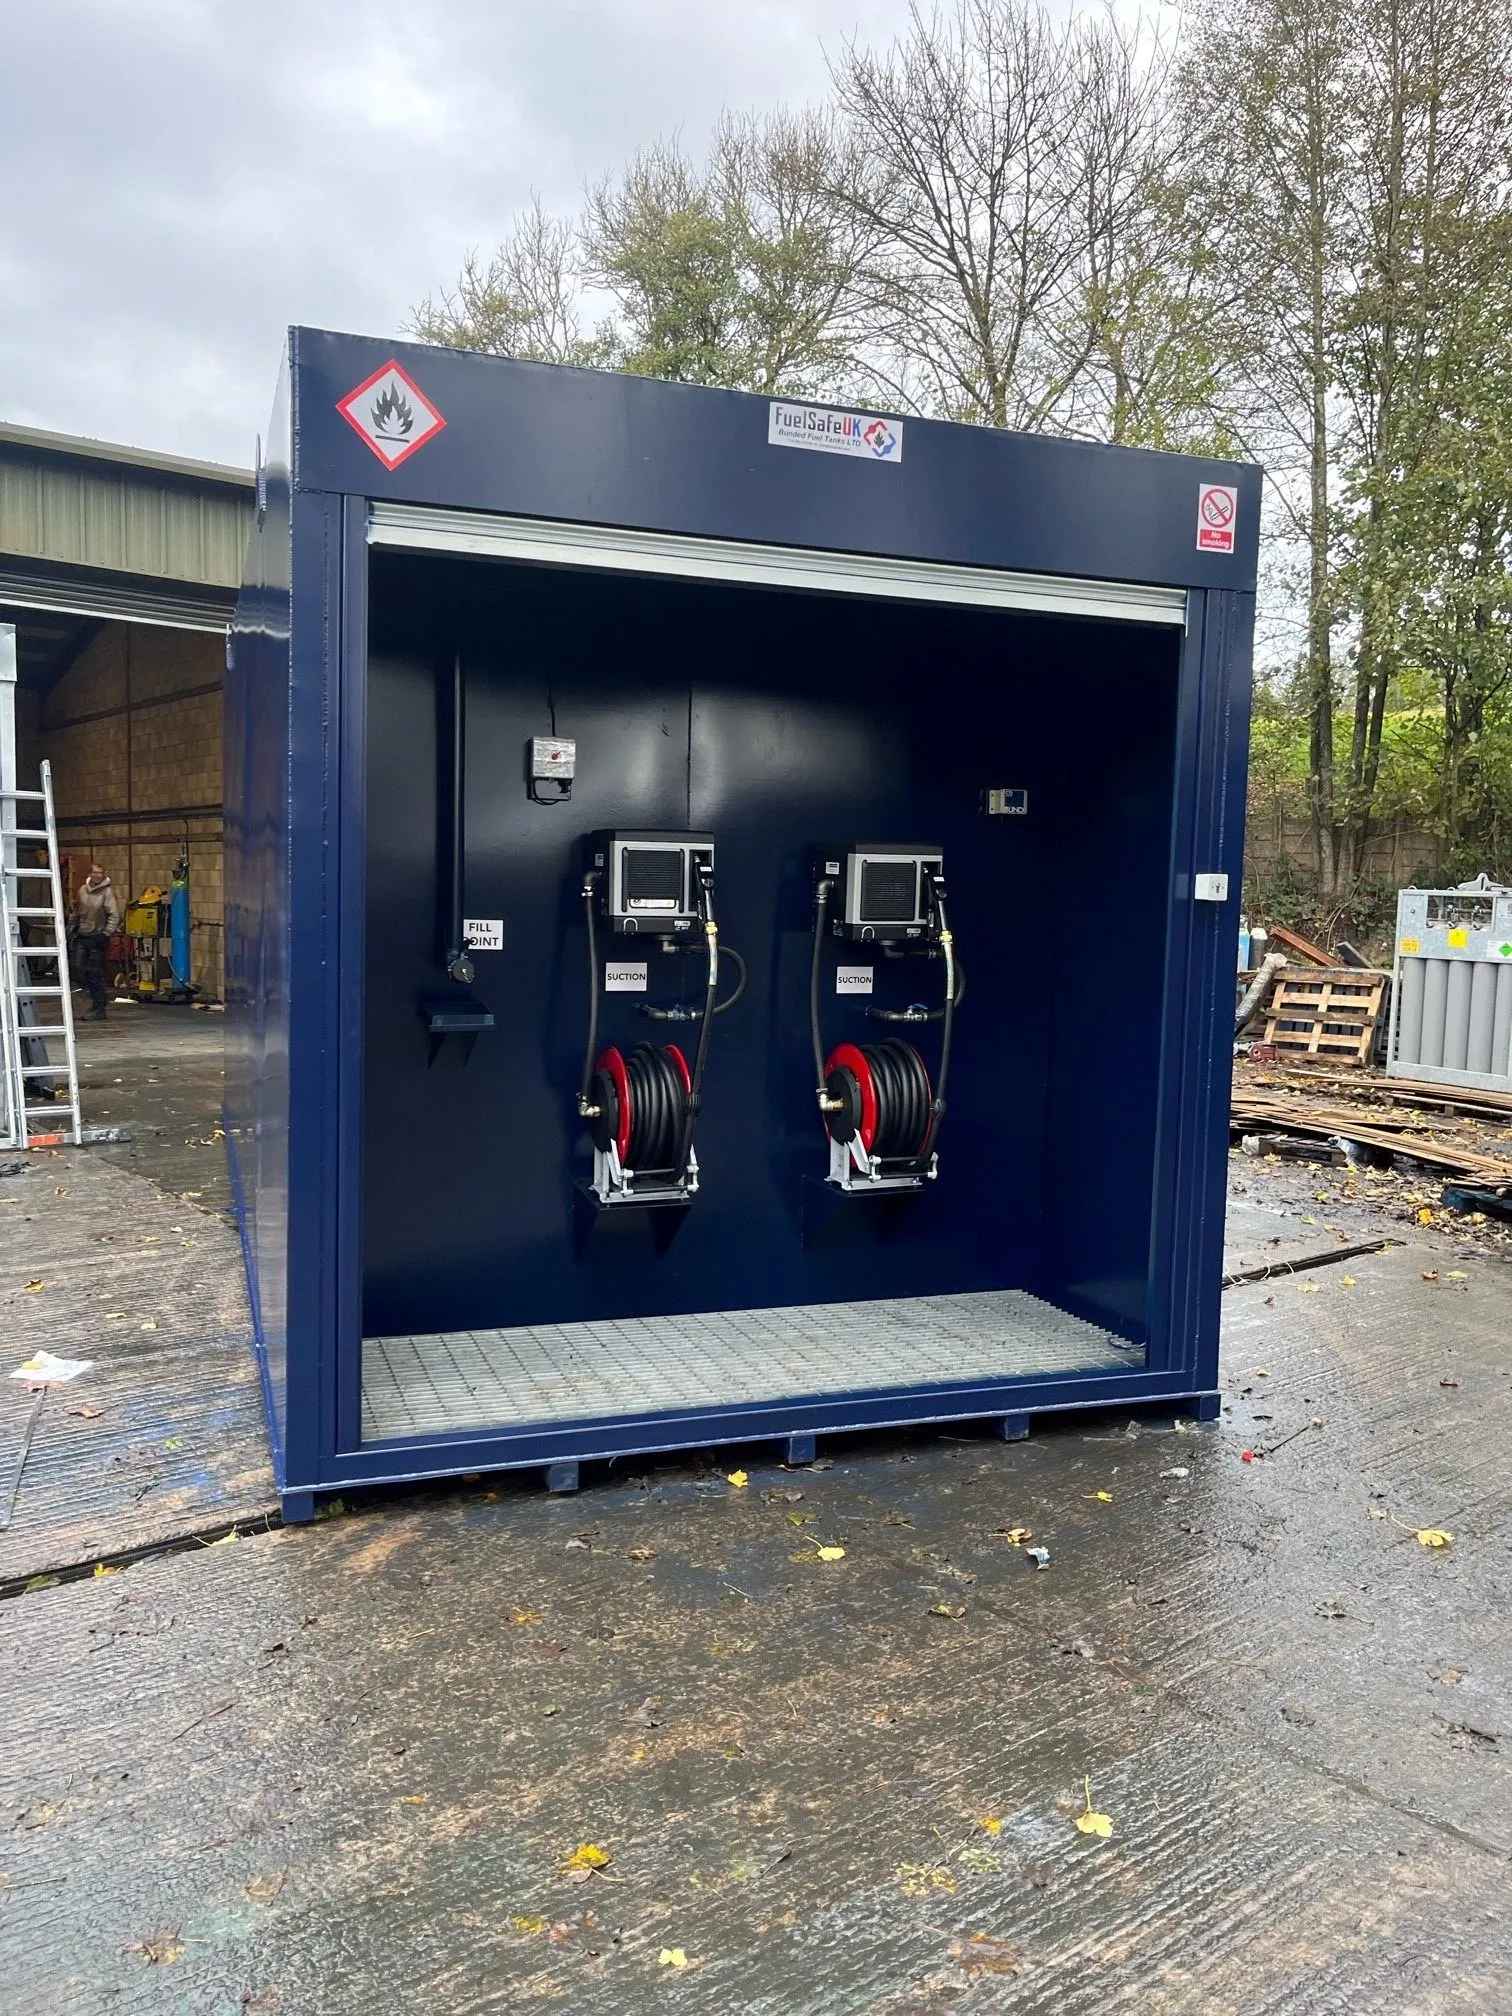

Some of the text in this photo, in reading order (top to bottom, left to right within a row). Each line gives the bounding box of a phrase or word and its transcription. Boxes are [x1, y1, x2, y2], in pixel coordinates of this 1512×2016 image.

[778, 428, 806, 439] Bunded
[807, 432, 823, 441] Fuel
[825, 435, 845, 445] Tanks
[1210, 531, 1221, 539] No
[1201, 538, 1230, 549] smoking
[468, 922, 493, 932] FILL
[607, 973, 646, 981] SUCTION
[837, 976, 872, 984] SUCTION
